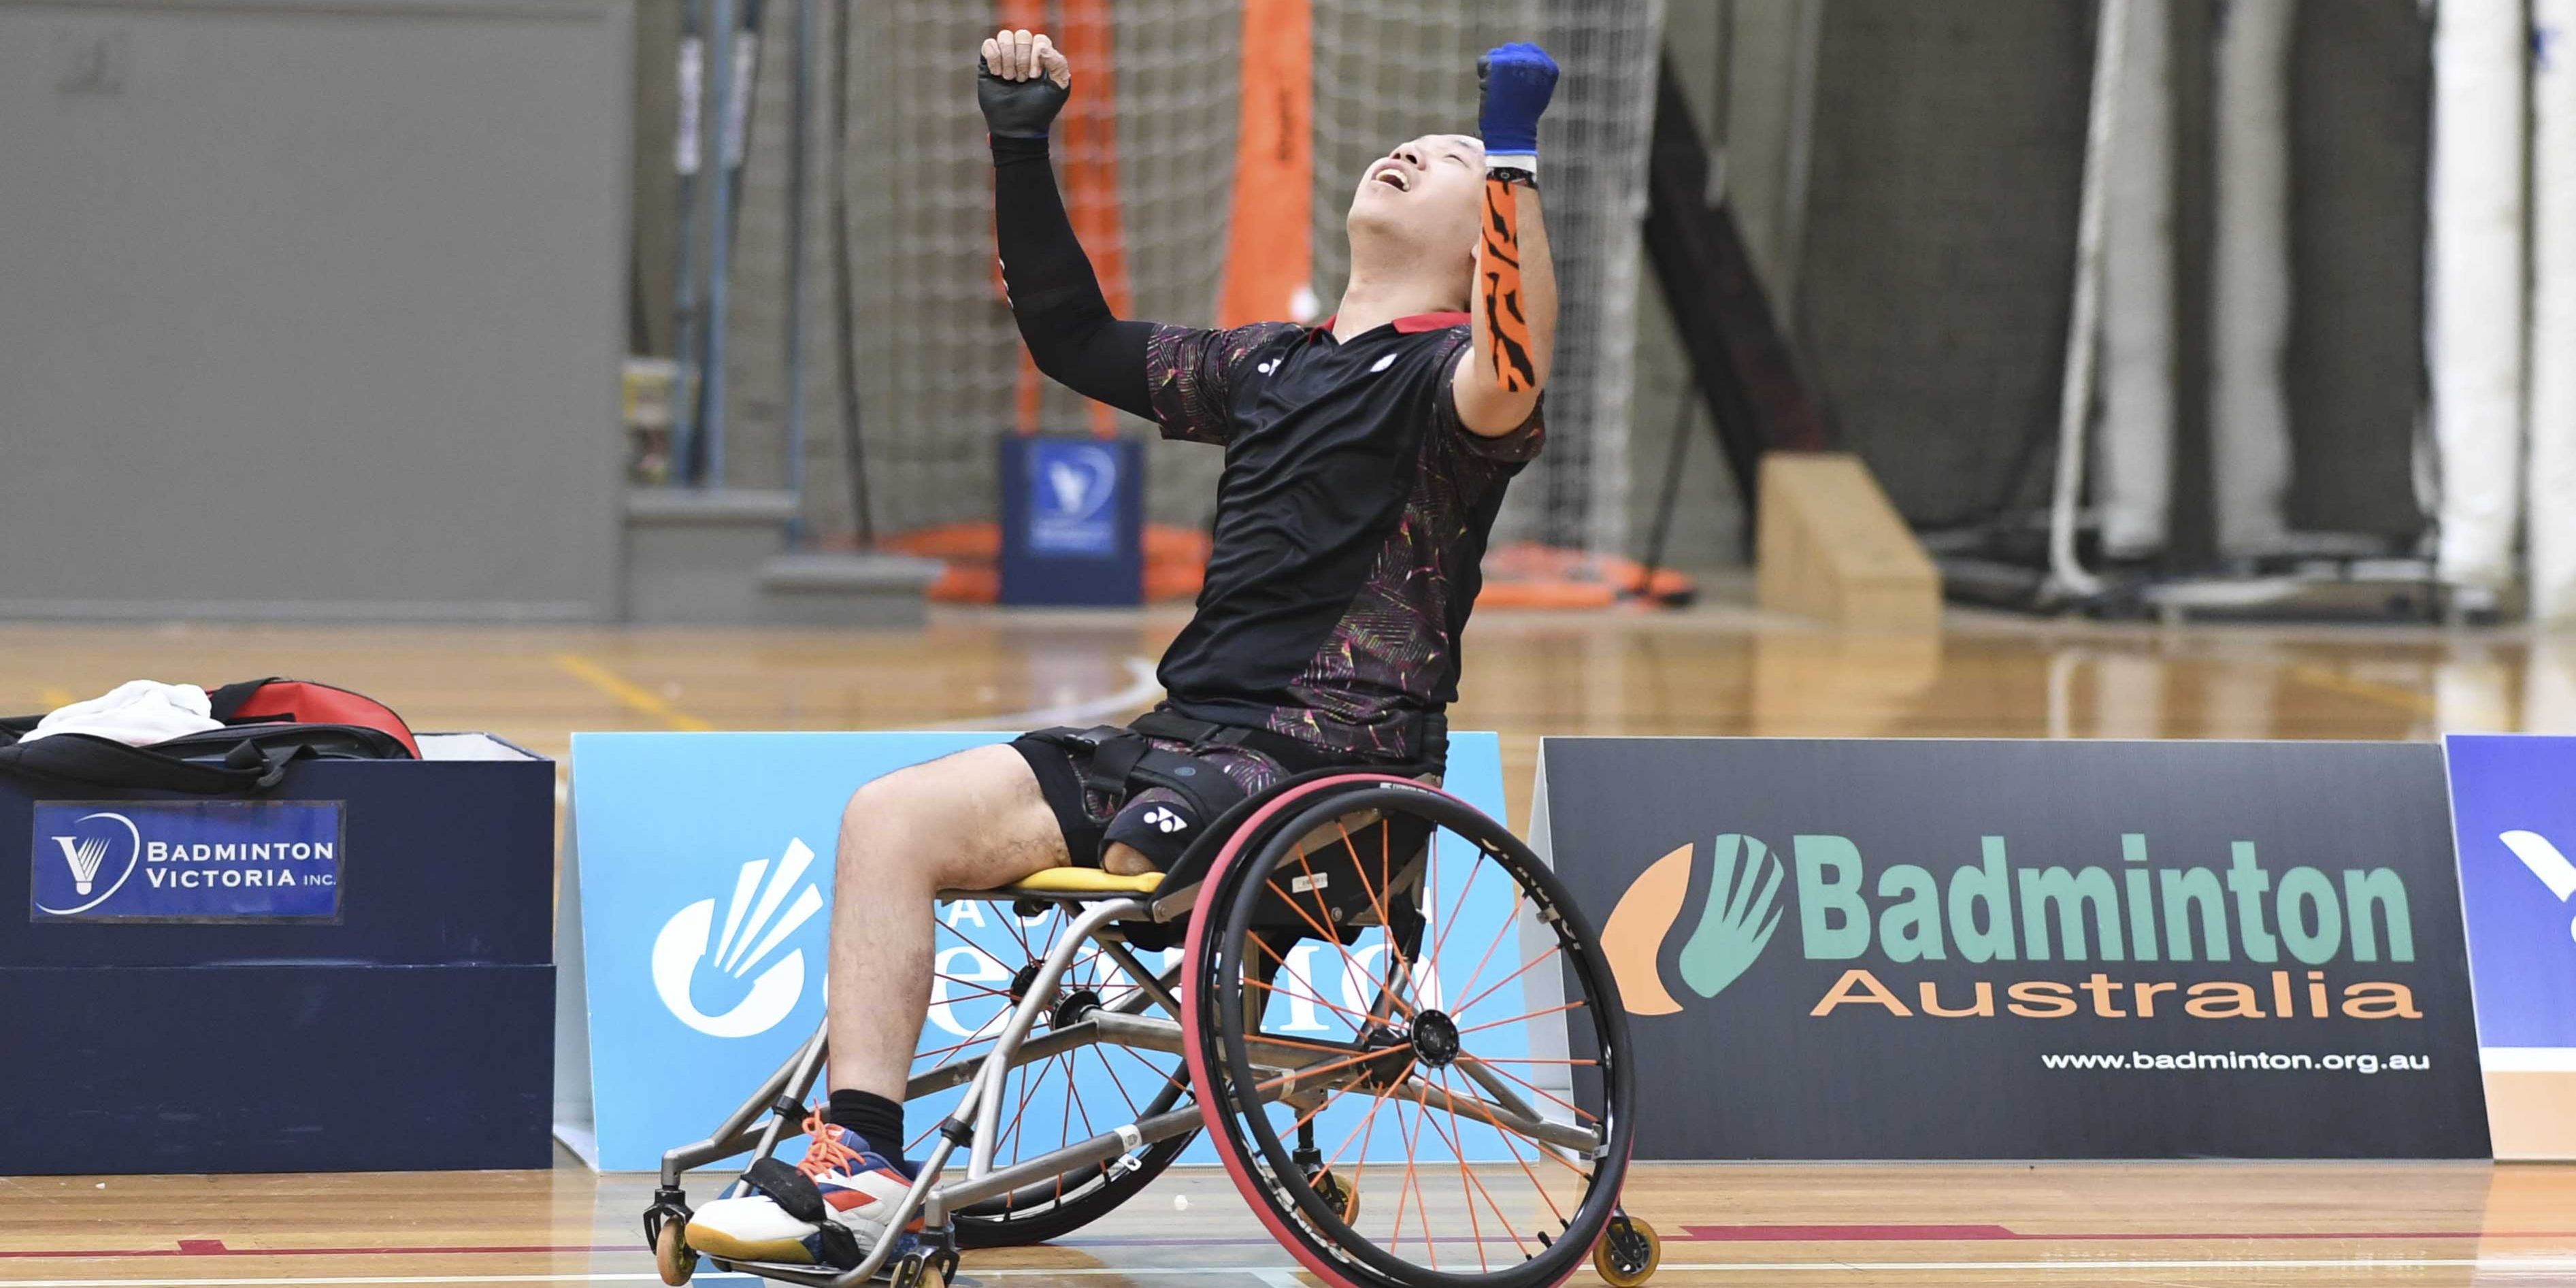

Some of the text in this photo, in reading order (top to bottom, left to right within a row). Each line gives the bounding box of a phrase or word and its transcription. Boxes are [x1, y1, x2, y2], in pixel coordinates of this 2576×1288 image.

[148, 841, 333, 862] BADMINTON
[146, 868, 336, 889] VICTORIA INC.
[1794, 833, 2415, 965] Badminton
[1810, 969, 2423, 1019] Australia
[2041, 1051, 2430, 1074] www.badminton.org.au
